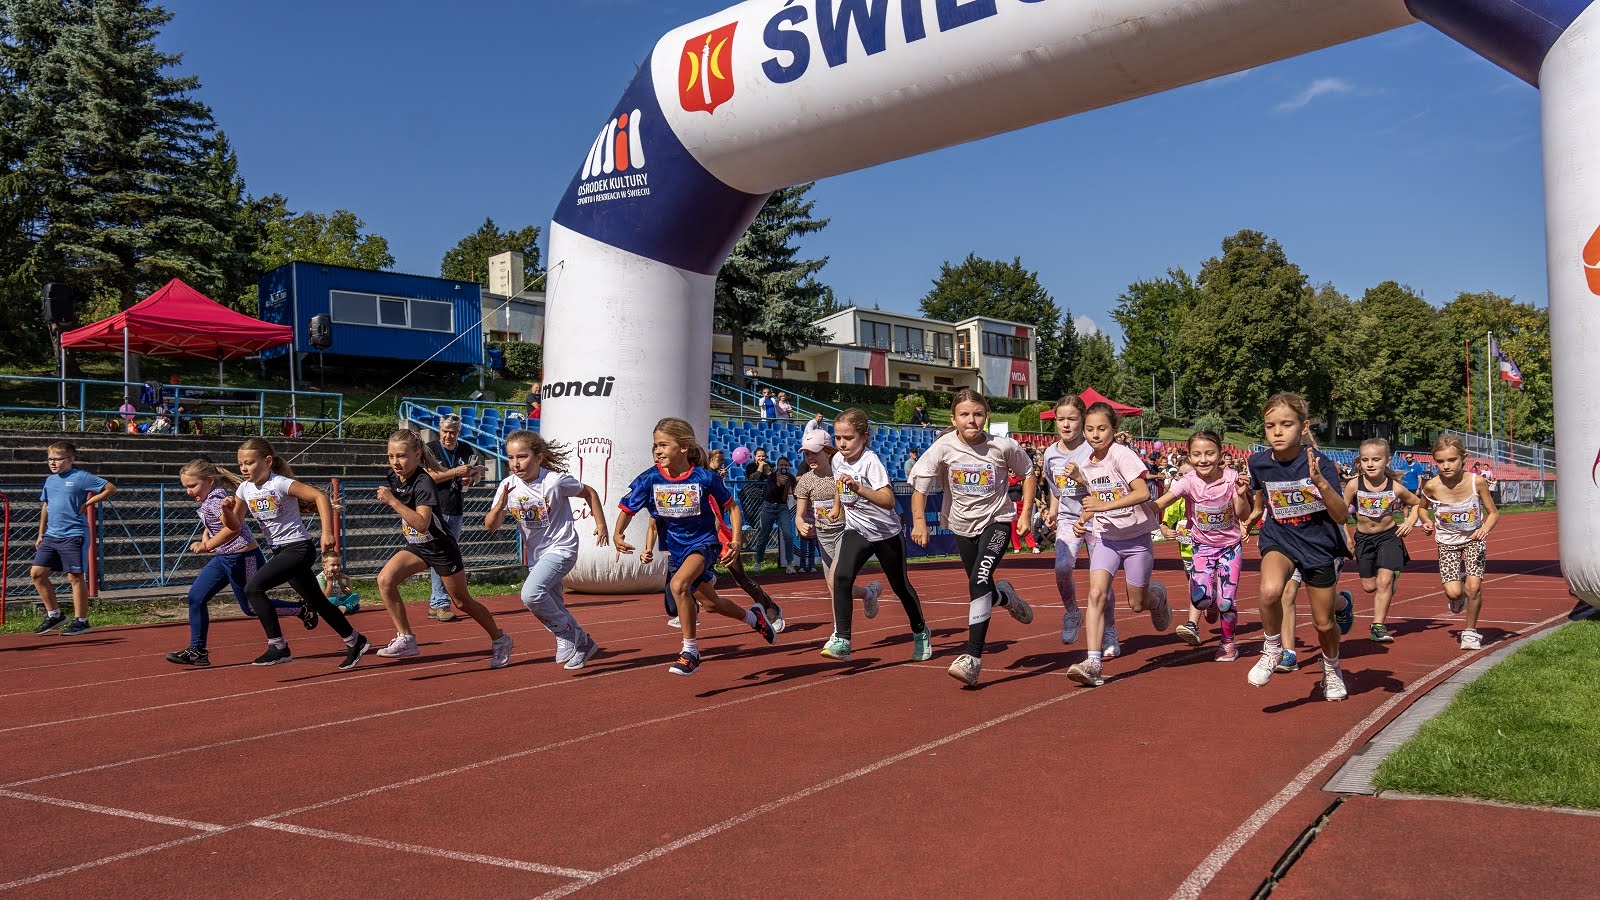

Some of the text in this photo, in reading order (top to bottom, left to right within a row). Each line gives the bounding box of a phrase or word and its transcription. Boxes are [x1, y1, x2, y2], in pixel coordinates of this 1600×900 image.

[761, 0, 1041, 84] ŚWI
[577, 173, 648, 196] OŚRODEK KULTURY
[576, 196, 593, 206] SPORTU
[621, 190, 627, 199] W
[1011, 371, 1026, 382] WDA
[541, 376, 615, 400] mondi
[964, 471, 980, 484] 10
[667, 493, 687, 506] 42
[1099, 491, 1114, 502] 93
[1283, 490, 1305, 504] 76
[256, 499, 270, 510] 99
[1372, 499, 1382, 508] 4
[1208, 513, 1225, 523] 63
[1451, 512, 1470, 523] 60
[976, 555, 996, 585] YORK
